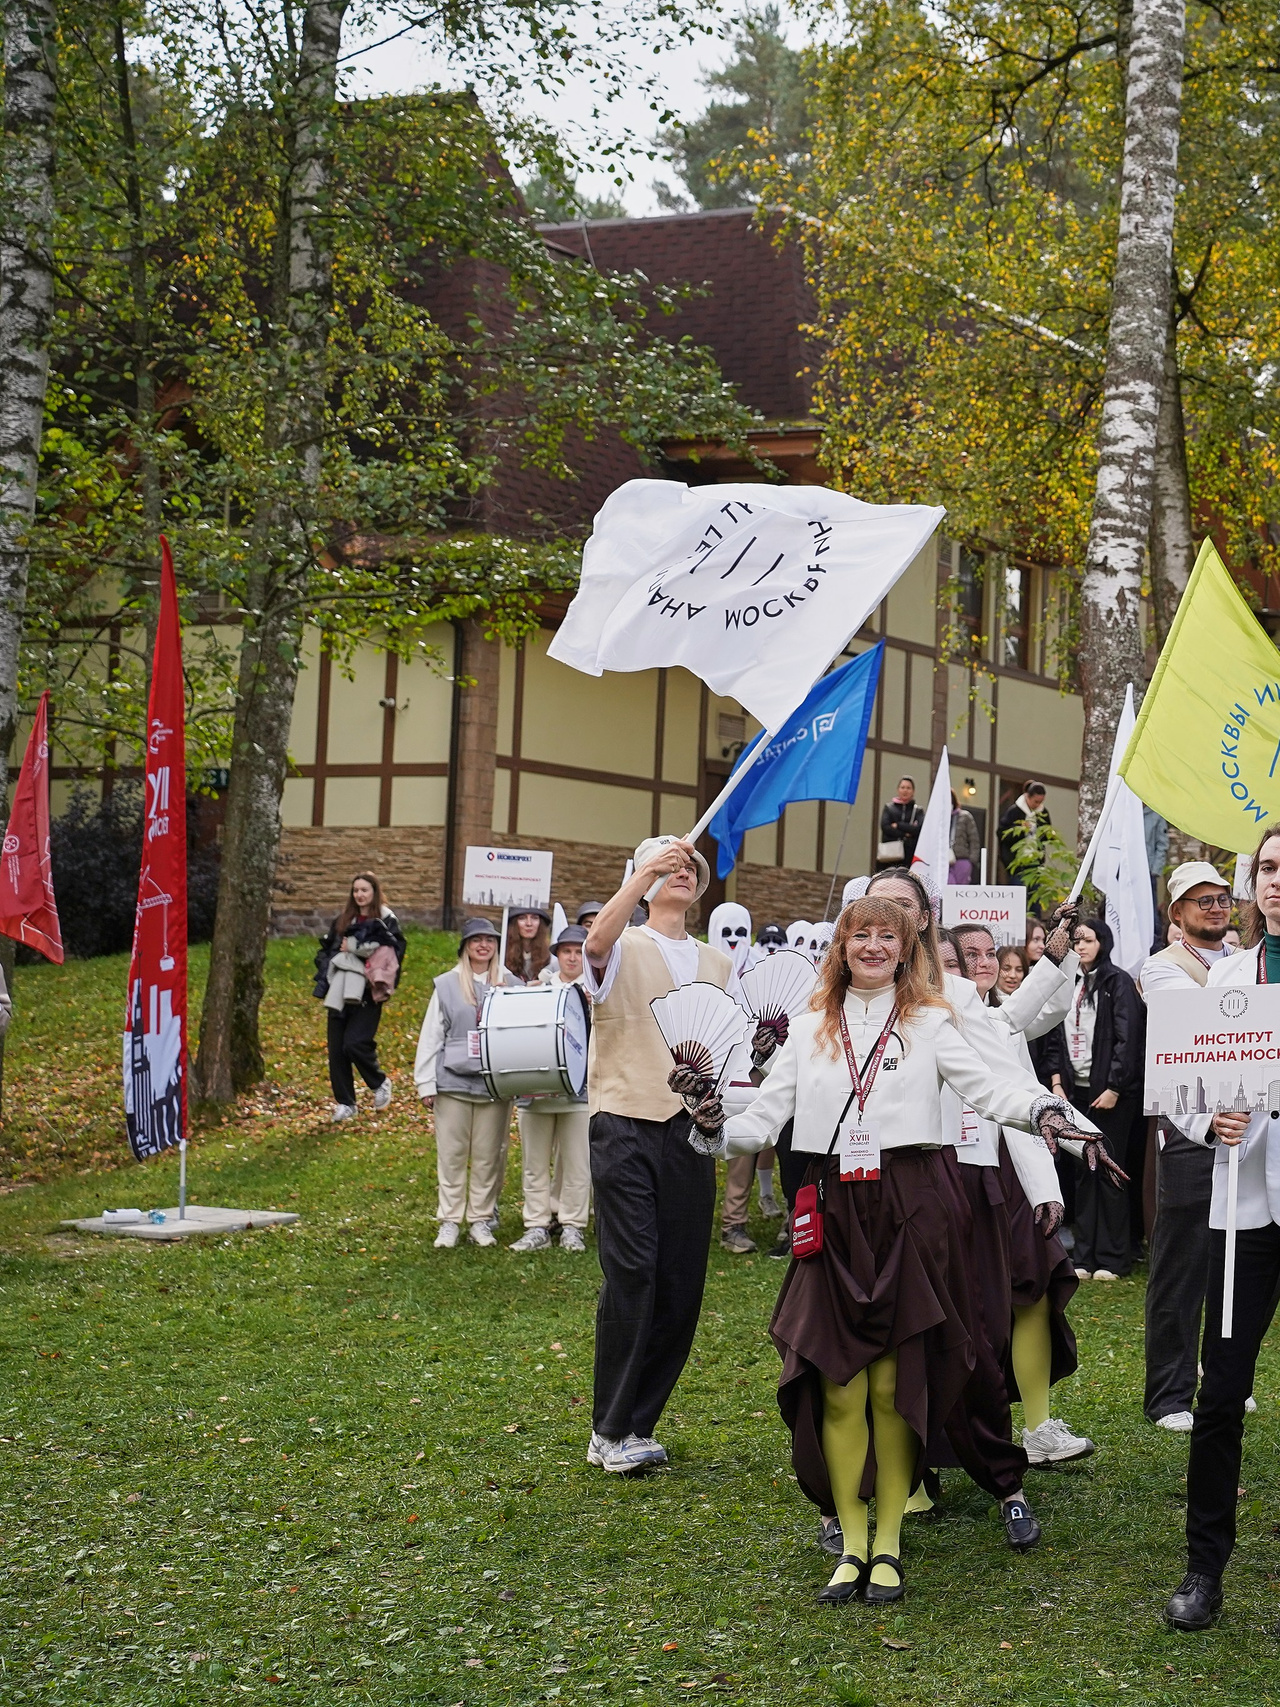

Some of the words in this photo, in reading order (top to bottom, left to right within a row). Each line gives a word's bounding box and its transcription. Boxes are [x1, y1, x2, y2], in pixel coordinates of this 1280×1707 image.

[1221, 703, 1269, 823] МОСКВЫ
[960, 909, 1010, 922] КОЛДИ
[1193, 1031, 1273, 1046] ИНСТИТУТ
[1156, 1050, 1237, 1065] ГЕНПЛАНА
